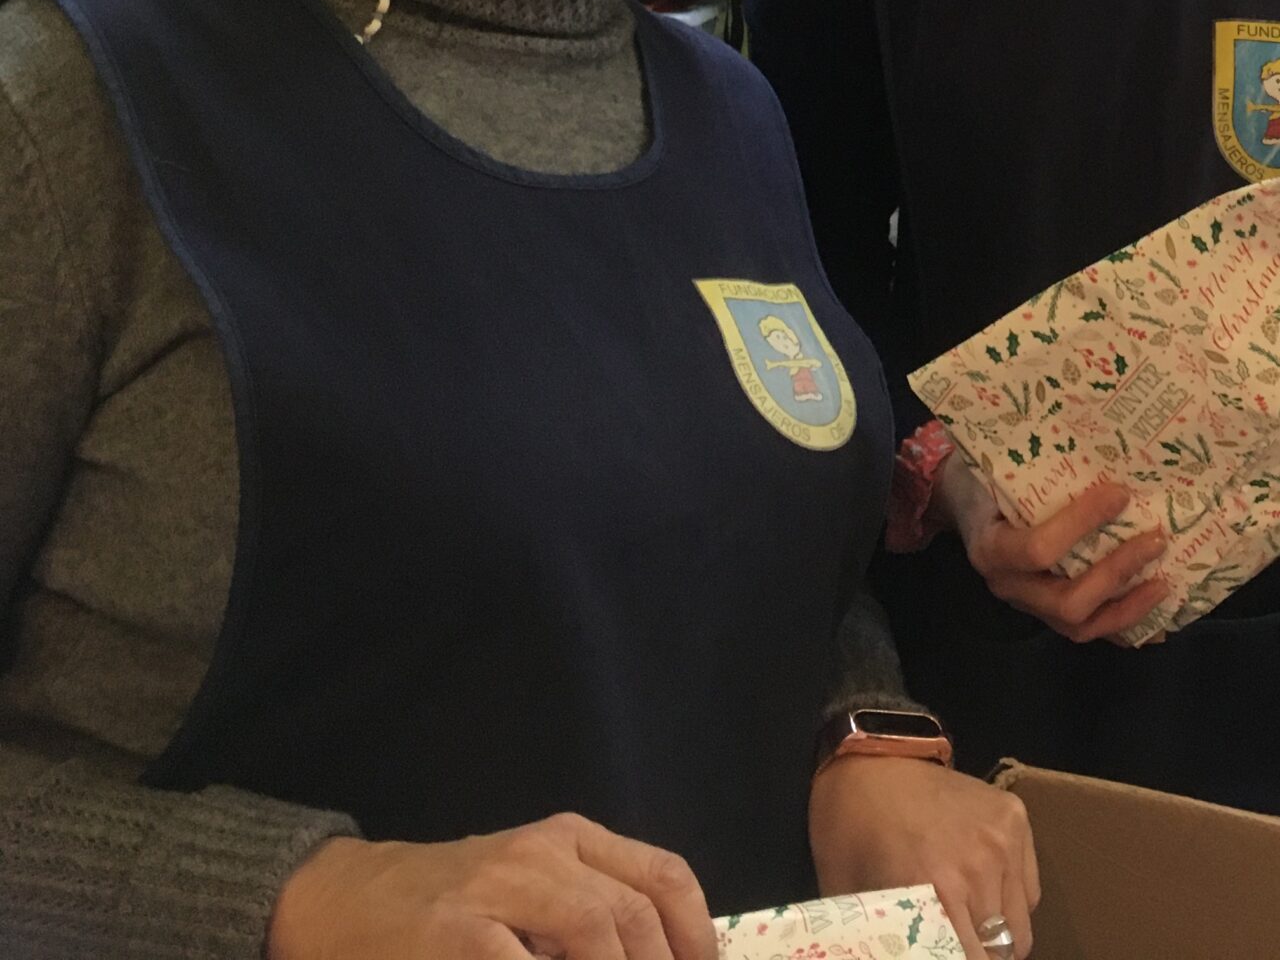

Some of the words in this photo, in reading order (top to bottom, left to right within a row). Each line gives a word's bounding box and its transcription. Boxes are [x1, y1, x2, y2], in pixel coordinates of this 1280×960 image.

[1217, 87, 1265, 180] MENSAJEROS
[718, 283, 801, 301] FUNDACION
[1198, 241, 1254, 308] Merry
[733, 347, 811, 441] MENSAJEROS
[1103, 363, 1169, 424] WINTER
[1128, 381, 1189, 441] WISHES
[1017, 456, 1077, 518] Merry
